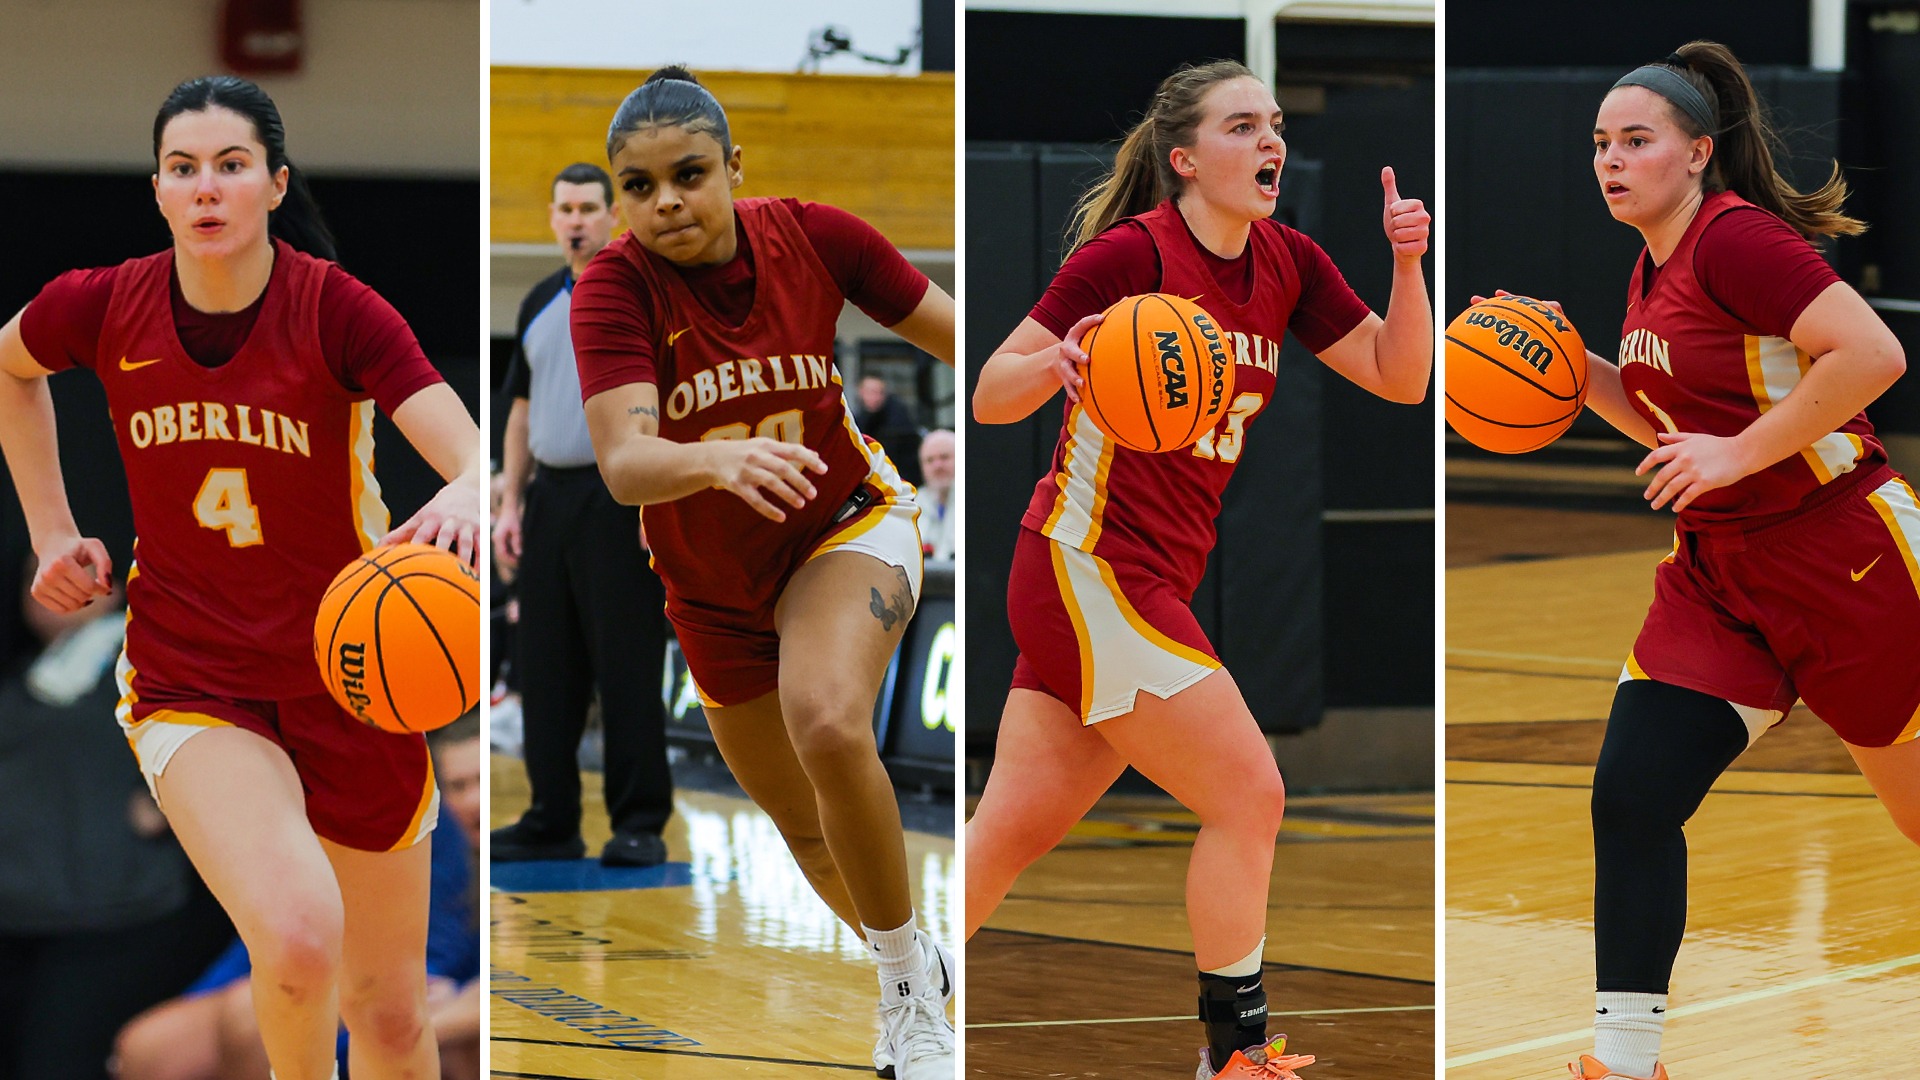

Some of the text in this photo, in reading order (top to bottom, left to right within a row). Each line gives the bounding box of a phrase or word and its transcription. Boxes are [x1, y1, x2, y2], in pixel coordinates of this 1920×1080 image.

[1154, 331, 1189, 410] NCAA
[1193, 314, 1227, 416] Wilson
[1465, 312, 1554, 376] Wilson
[666, 354, 828, 420] OBERLIN
[130, 401, 311, 457] OBERLIN
[193, 468, 264, 548] 4
